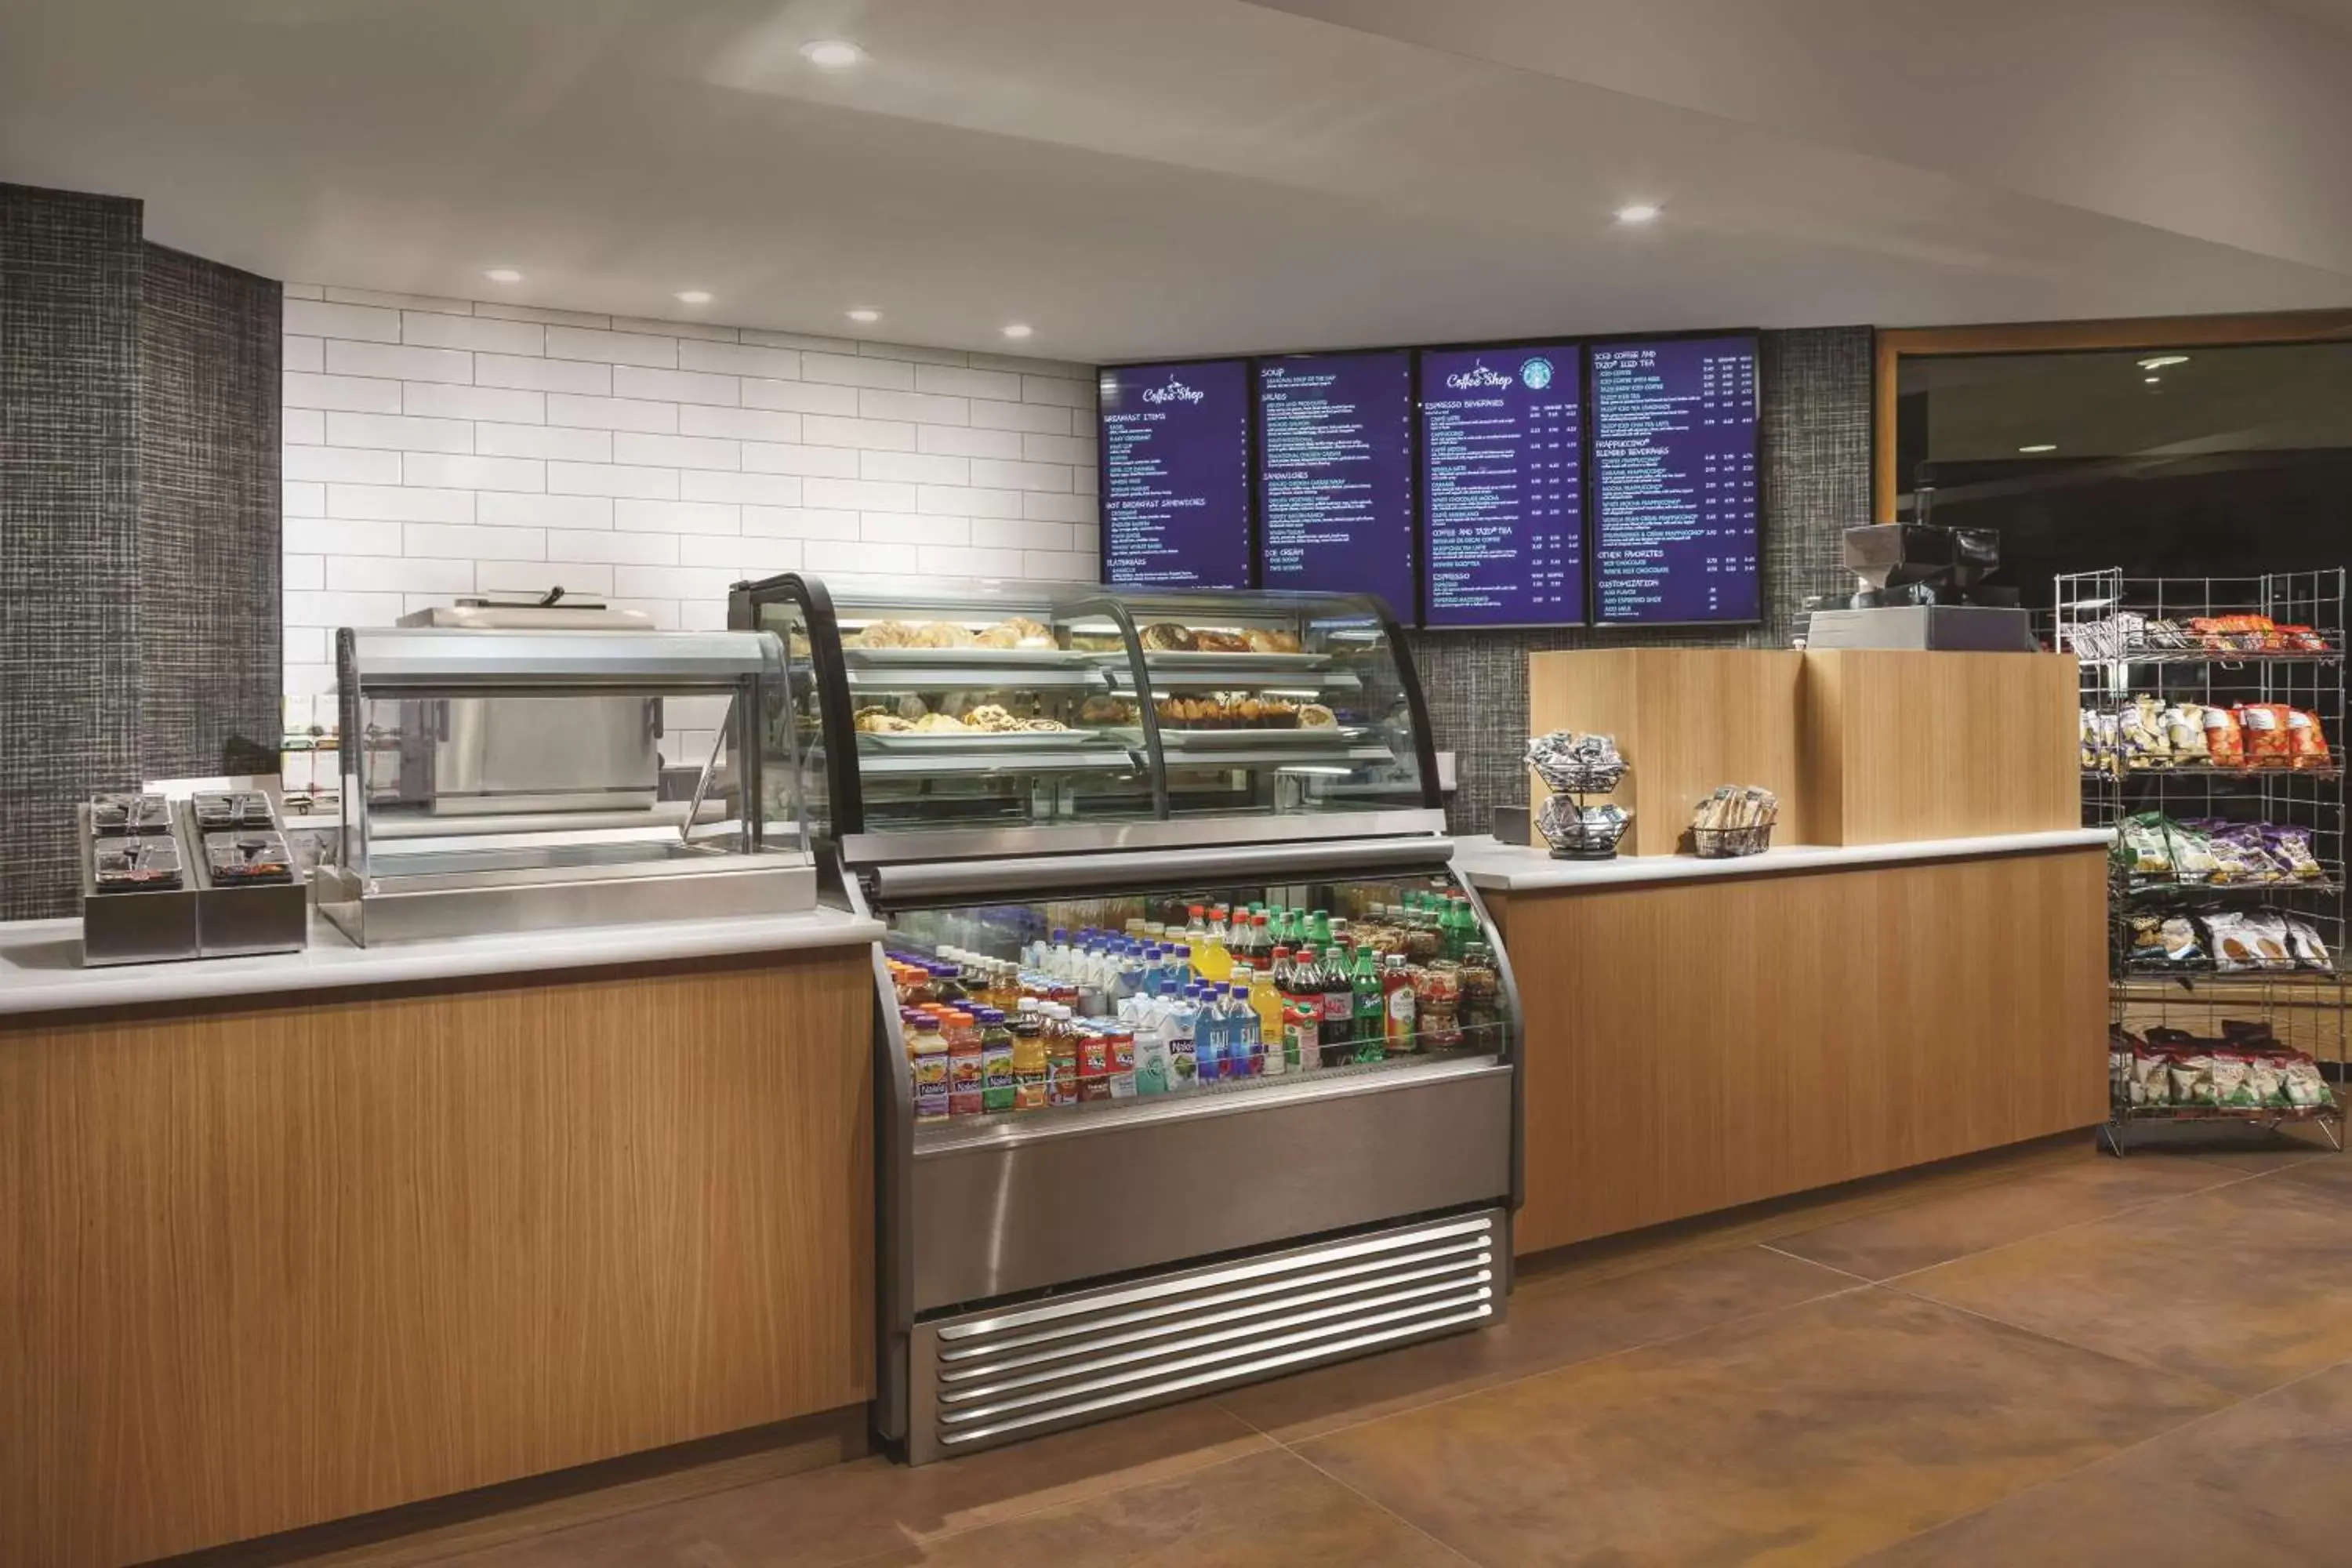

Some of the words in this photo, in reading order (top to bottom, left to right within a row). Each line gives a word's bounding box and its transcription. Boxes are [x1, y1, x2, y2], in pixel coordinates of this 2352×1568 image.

[1261, 368, 1285, 377] SOUP
[1446, 374, 1481, 390] Coffee
[1484, 371, 1513, 390] Shop
[1142, 387, 1174, 404] Coffee
[1176, 385, 1205, 404] Shop
[1595, 448, 1626, 457] BLENDED
[1628, 446, 1669, 456] BEVERAGES
[1263, 472, 1308, 481] SANDWICHES
[1432, 528, 1456, 537] COFFEE
[1597, 550, 1621, 559] OTHER
[1624, 549, 1664, 558] FAVORITES
[1599, 579, 1660, 589] CUSTOMIZATION
